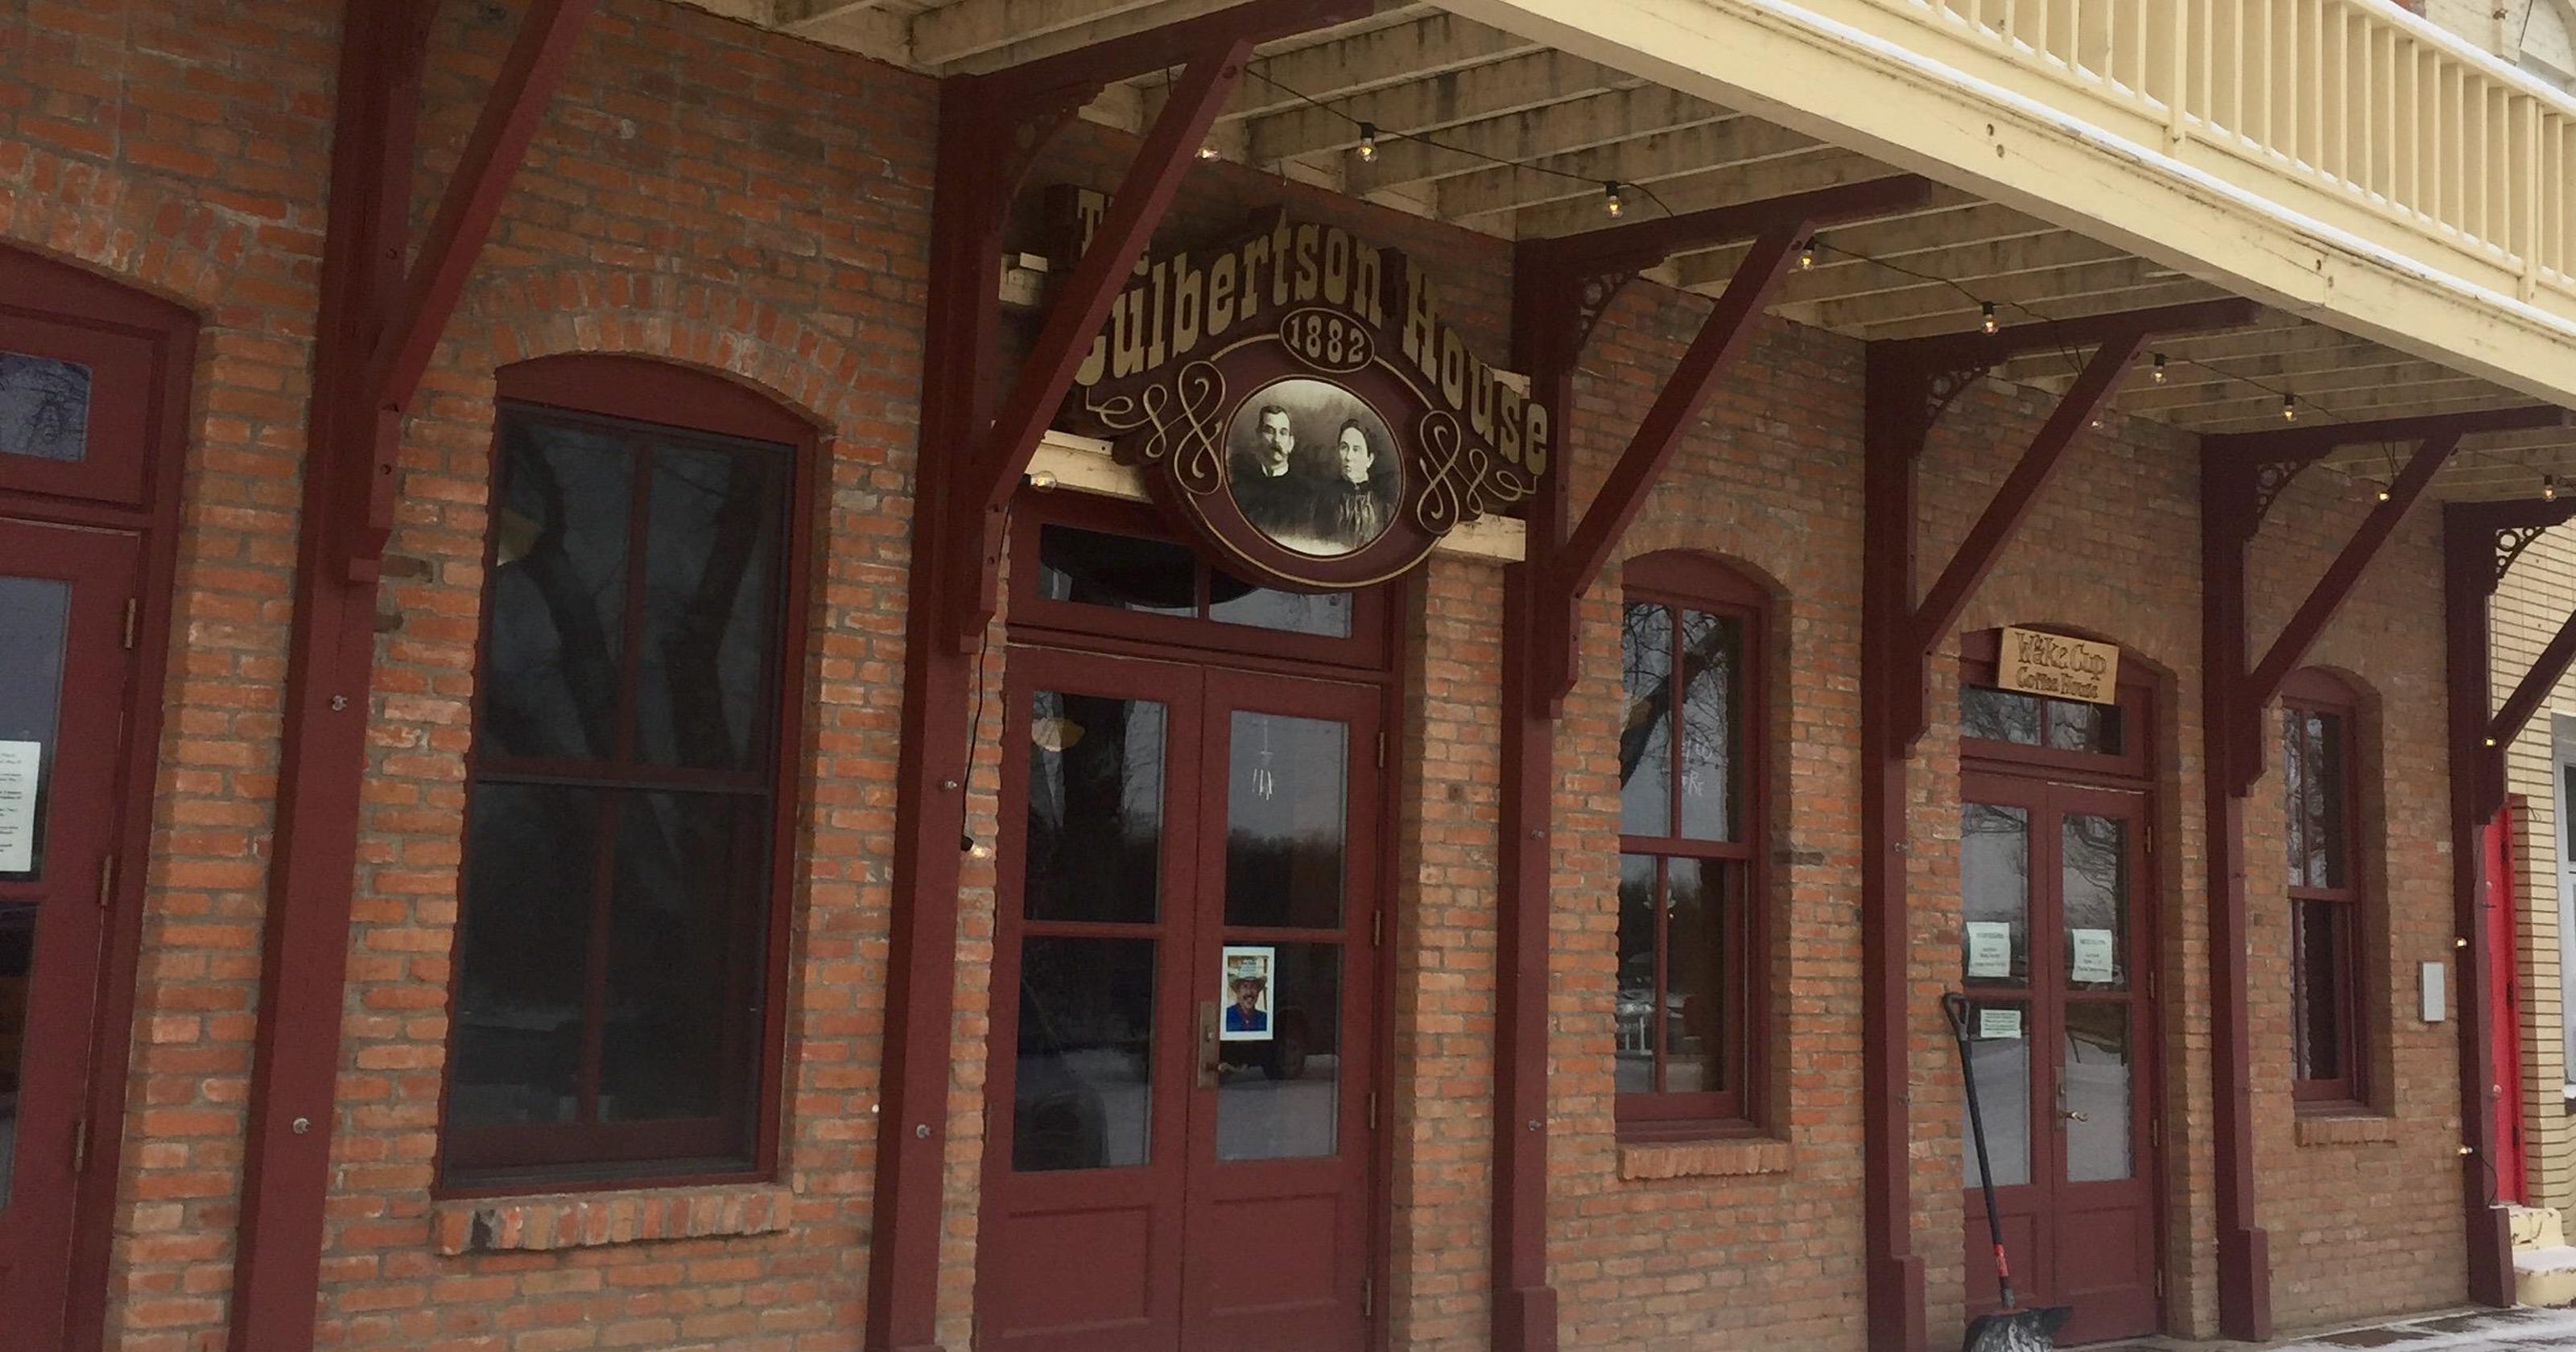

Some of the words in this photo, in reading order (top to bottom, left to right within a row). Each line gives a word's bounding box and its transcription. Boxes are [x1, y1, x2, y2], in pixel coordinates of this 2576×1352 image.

[1290, 315, 1365, 364] 1882
[1401, 252, 1548, 476] House
[2070, 644, 2107, 681] Cup
